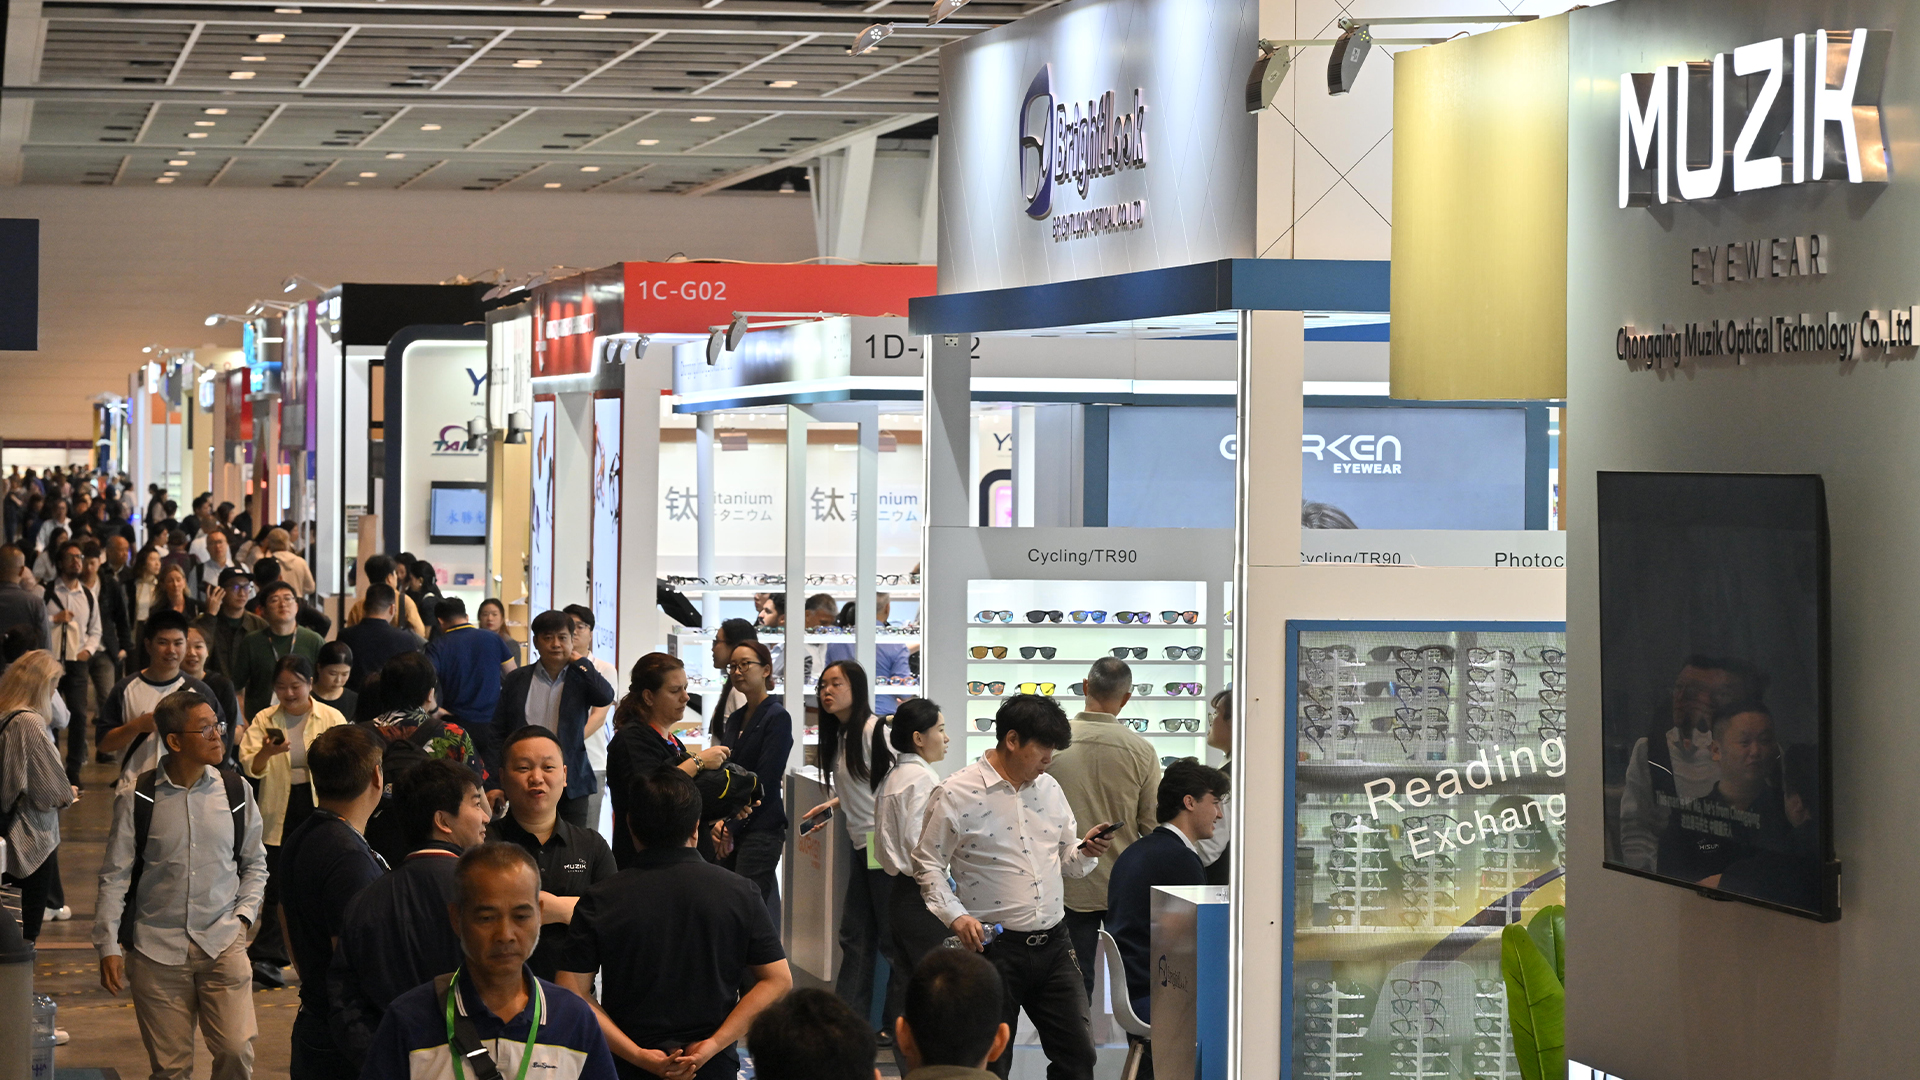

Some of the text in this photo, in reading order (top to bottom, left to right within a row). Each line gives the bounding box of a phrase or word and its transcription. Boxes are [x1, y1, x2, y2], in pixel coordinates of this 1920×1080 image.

[1619, 28, 1872, 208] MUZIK
[1055, 88, 1145, 197] BrightLook
[1691, 234, 1824, 286] EYEWEAR
[638, 280, 728, 301] 1C-G02
[866, 334, 980, 360] 1D-2
[1616, 323, 1682, 369] Chongqing
[1684, 319, 1724, 357] Muzik
[1727, 314, 1773, 365] Optical
[1775, 311, 1857, 362] Technology
[1333, 463, 1402, 474] EYEWEAR
[664, 486, 699, 522] 钛
[713, 491, 773, 505] itanium
[810, 487, 845, 522] 钛
[850, 491, 918, 505] Tnium
[714, 509, 773, 522] タニウム
[1027, 548, 1138, 566] Cycling/TR90
[1494, 552, 1565, 568] Photoc
[1364, 736, 1566, 820] Reading
[1407, 793, 1566, 860] Exchang
